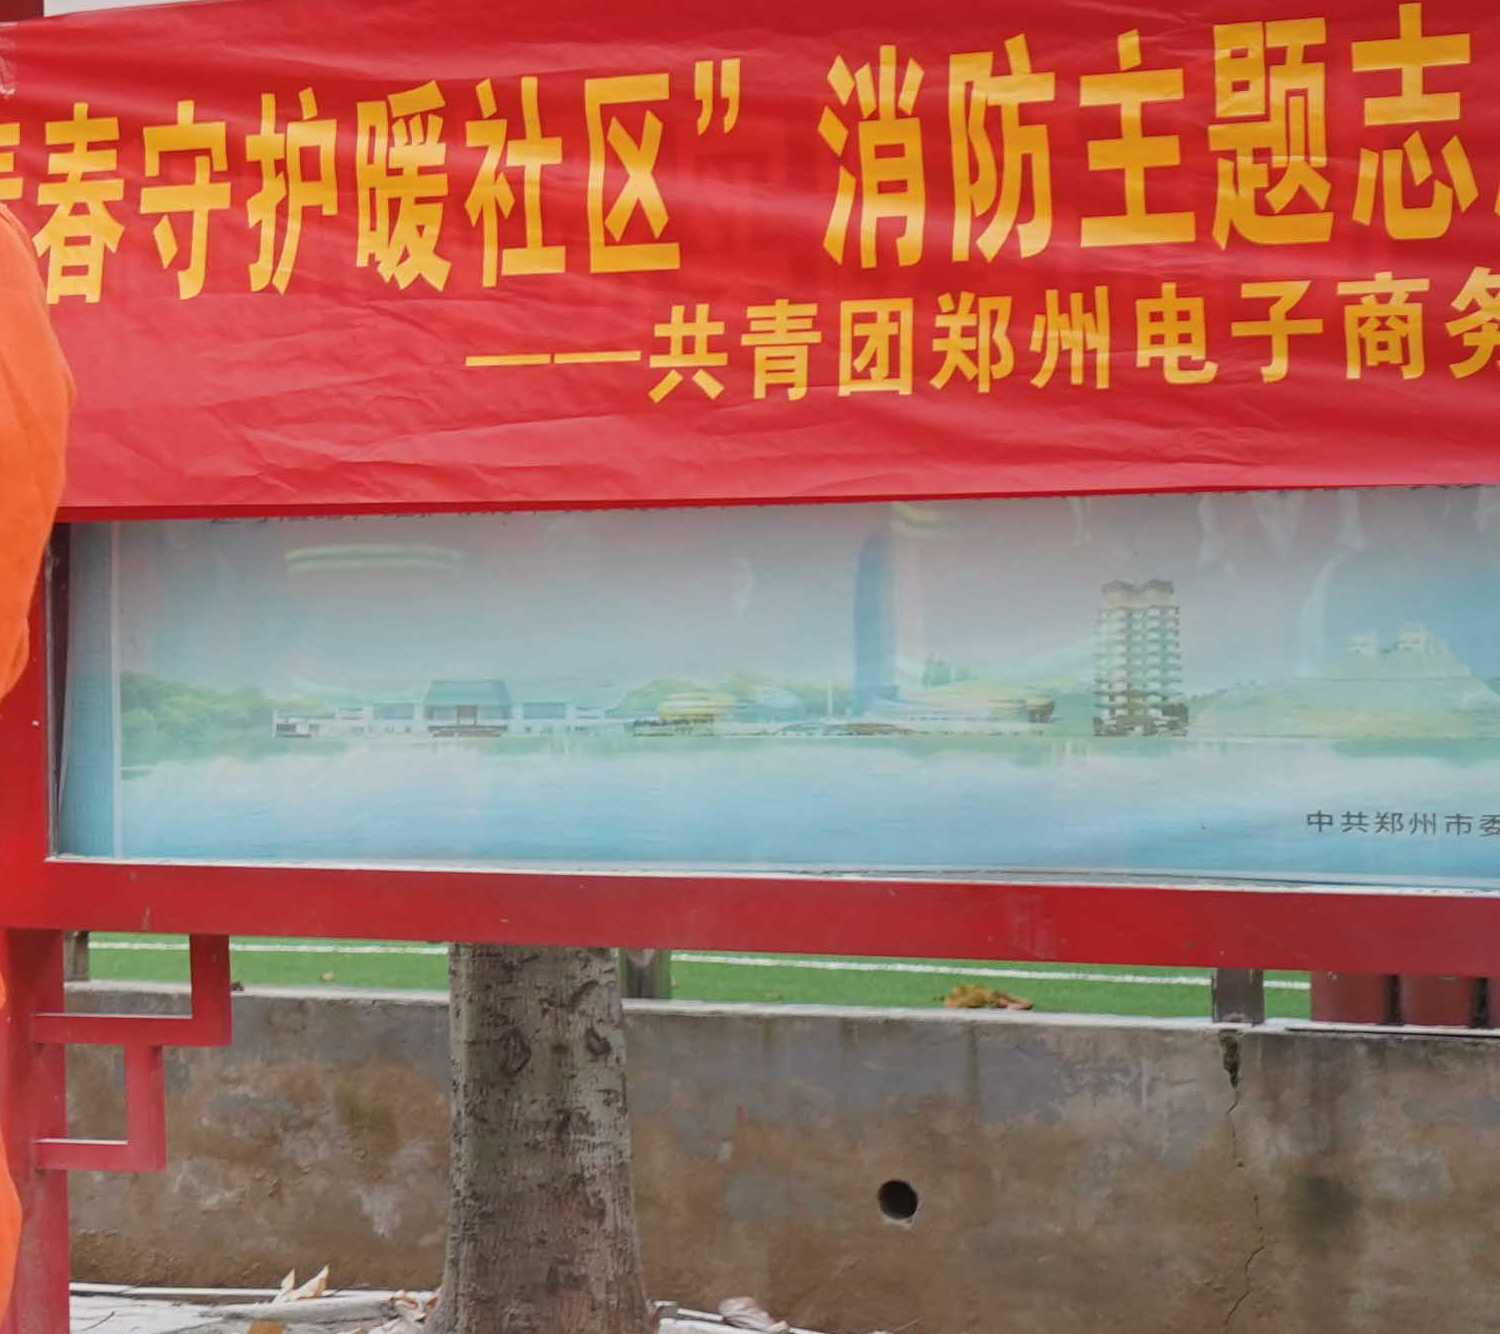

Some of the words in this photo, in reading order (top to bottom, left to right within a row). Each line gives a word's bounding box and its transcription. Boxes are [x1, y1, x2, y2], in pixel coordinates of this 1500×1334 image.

[1307, 809, 1500, 837] 中共郑州市委
